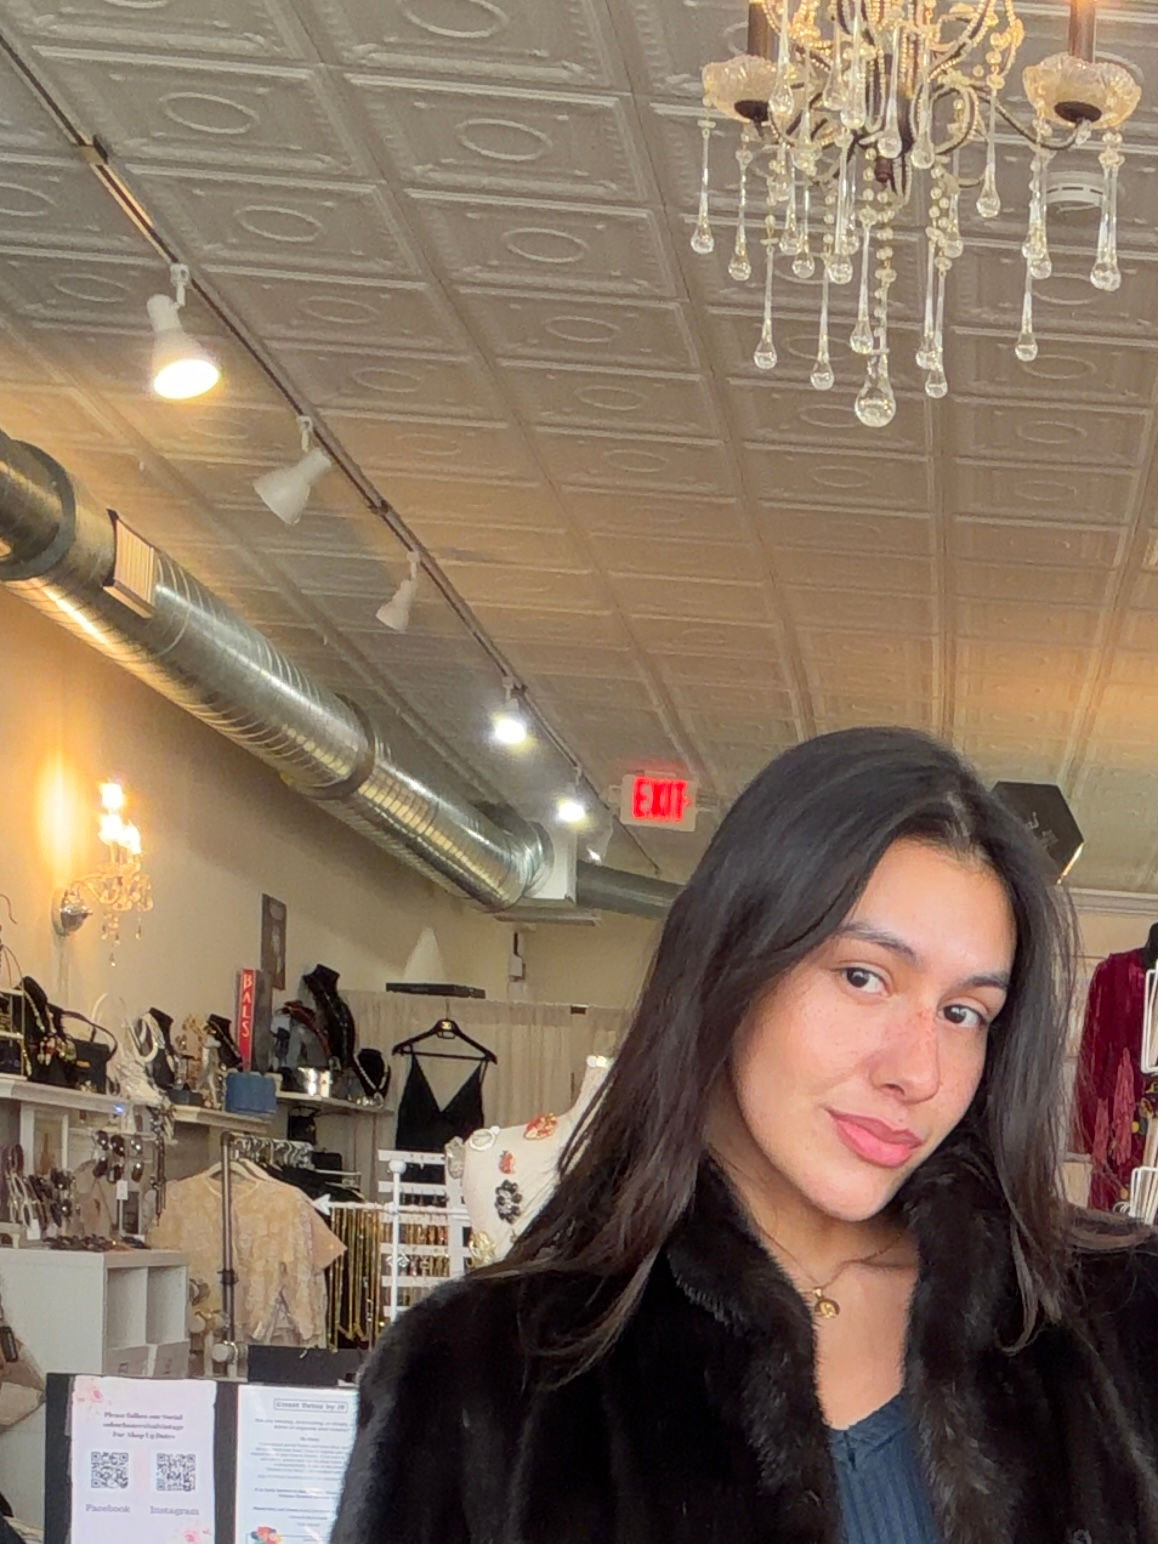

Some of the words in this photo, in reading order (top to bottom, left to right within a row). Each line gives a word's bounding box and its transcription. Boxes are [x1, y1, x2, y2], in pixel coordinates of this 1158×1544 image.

[633, 777, 687, 822] EXIT
[85, 1503, 131, 1514] Facebook
[149, 1505, 200, 1516] Instagram
